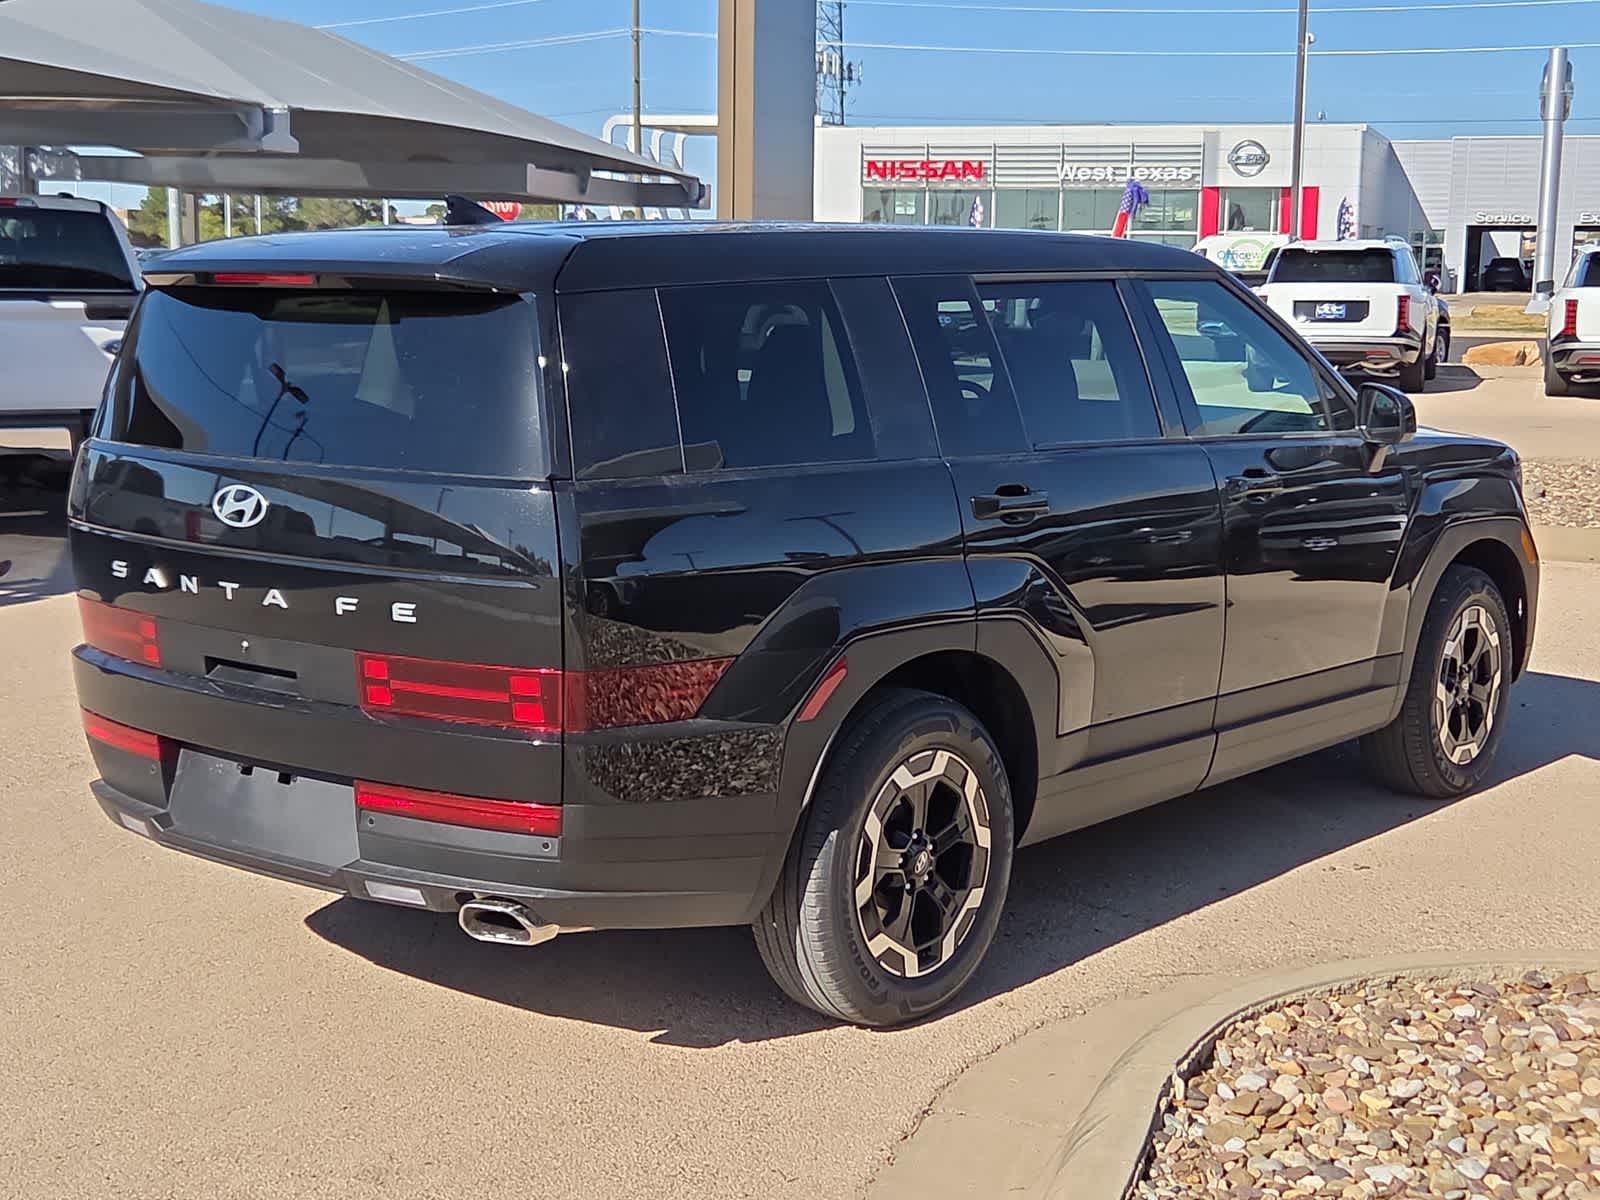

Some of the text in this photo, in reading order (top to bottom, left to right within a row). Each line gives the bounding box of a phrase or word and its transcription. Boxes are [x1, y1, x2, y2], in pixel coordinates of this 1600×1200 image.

[866, 160, 985, 180] NISSAN
[1056, 163, 1193, 181] West Texas
[1475, 211, 1532, 224] Service
[111, 560, 417, 623] SANTA FE
